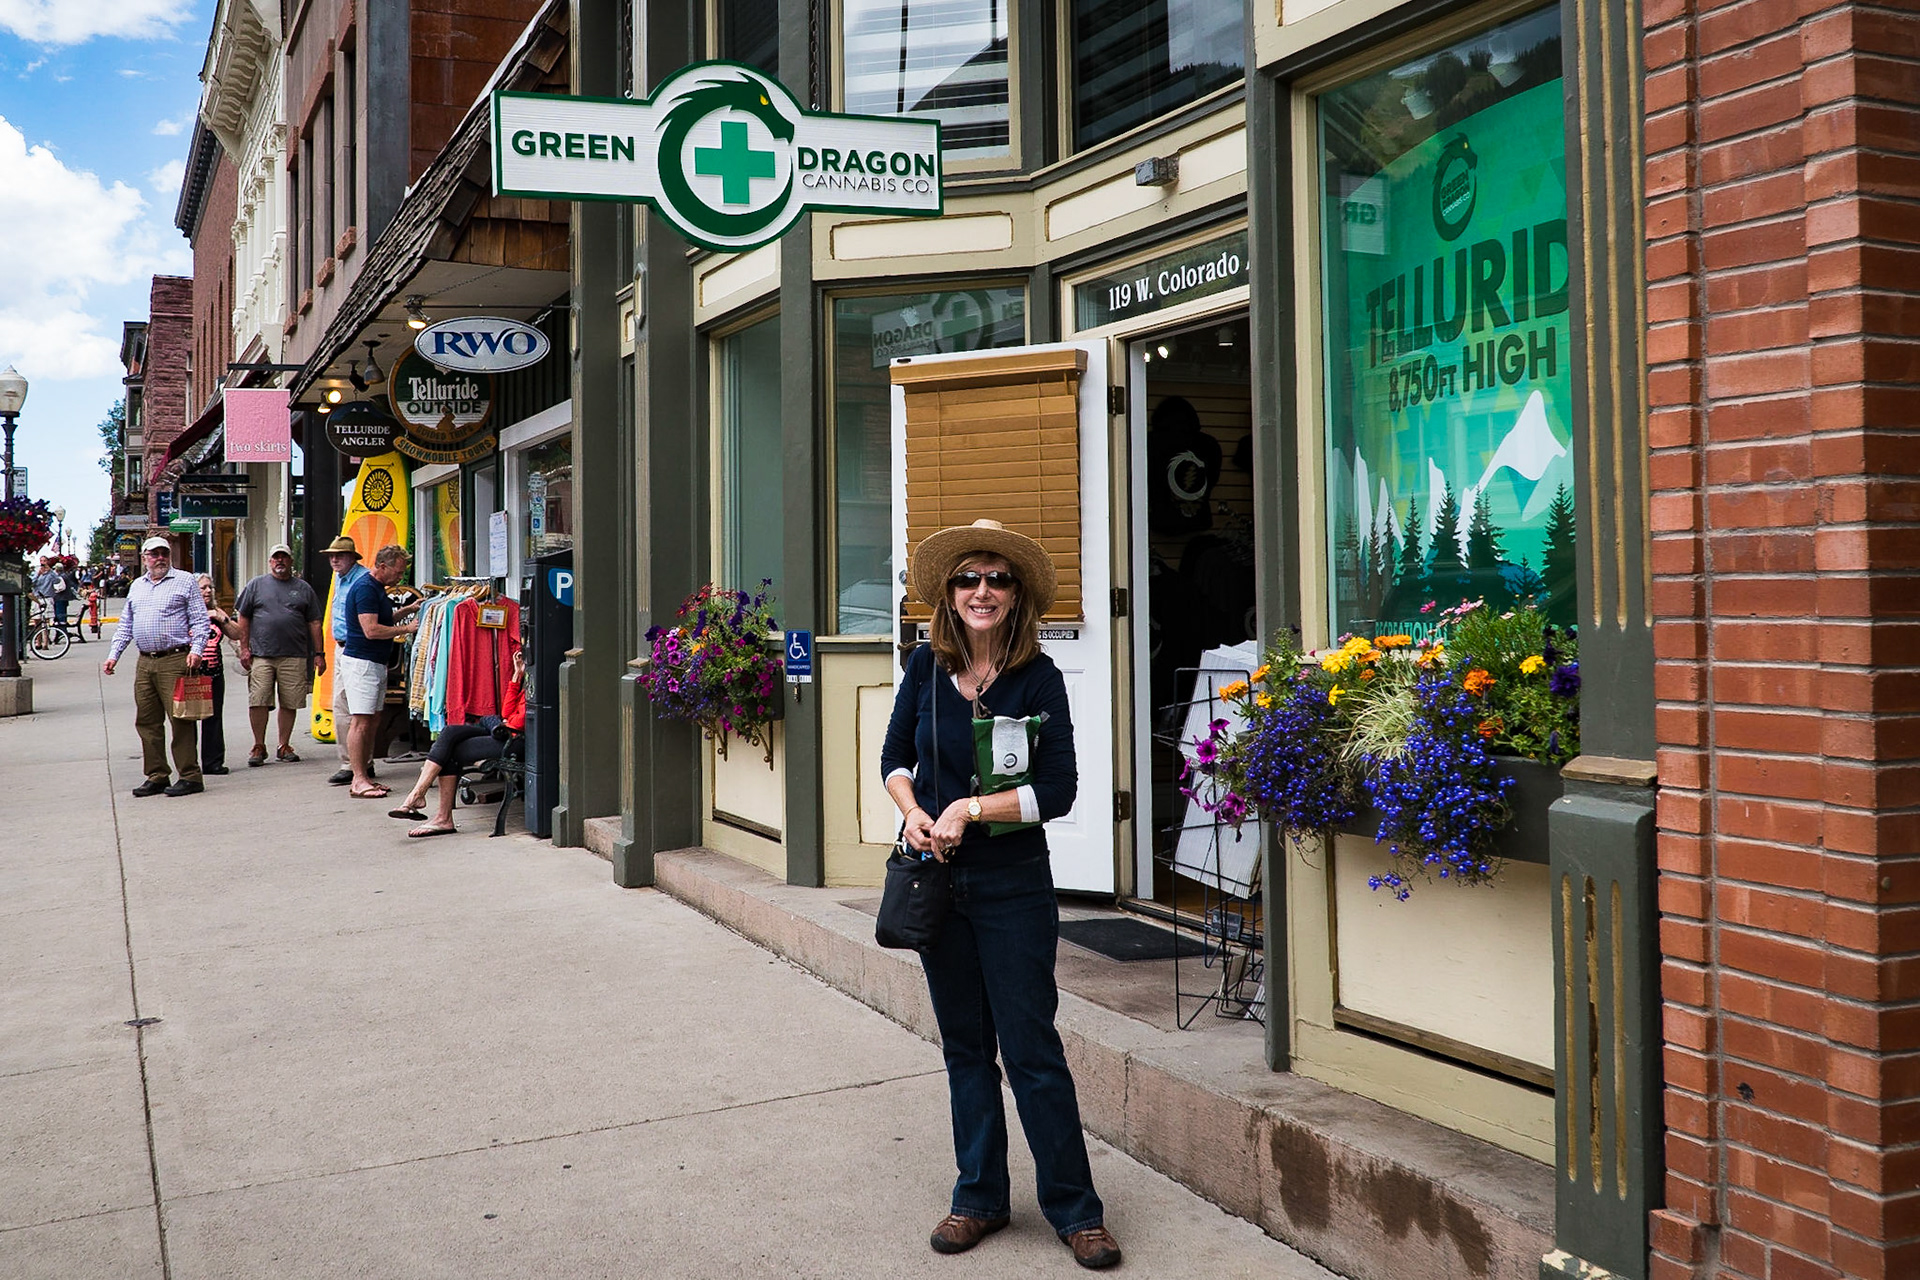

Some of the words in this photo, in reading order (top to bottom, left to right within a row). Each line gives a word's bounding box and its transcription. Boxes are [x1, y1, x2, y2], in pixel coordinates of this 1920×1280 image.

[511, 129, 635, 162] GREEN
[797, 146, 935, 177] DRAGON
[802, 173, 897, 193] CANNABIS
[902, 178, 934, 195] CO.
[1109, 283, 1131, 311] 119
[1135, 277, 1153, 303] W.
[1158, 252, 1240, 296] Colorado
[431, 327, 538, 359] RWO
[1462, 326, 1557, 393] HIGH
[408, 376, 479, 401] Telluride
[406, 401, 482, 415] OUTSIDE
[334, 424, 391, 435] TELLURIDE
[341, 436, 386, 446] ANGLER
[230, 440, 251, 454] two
[254, 440, 287, 454] skirts
[398, 439, 459, 463] SNOWMOBILE
[462, 439, 493, 460] TOURS
[556, 572, 573, 600] P
